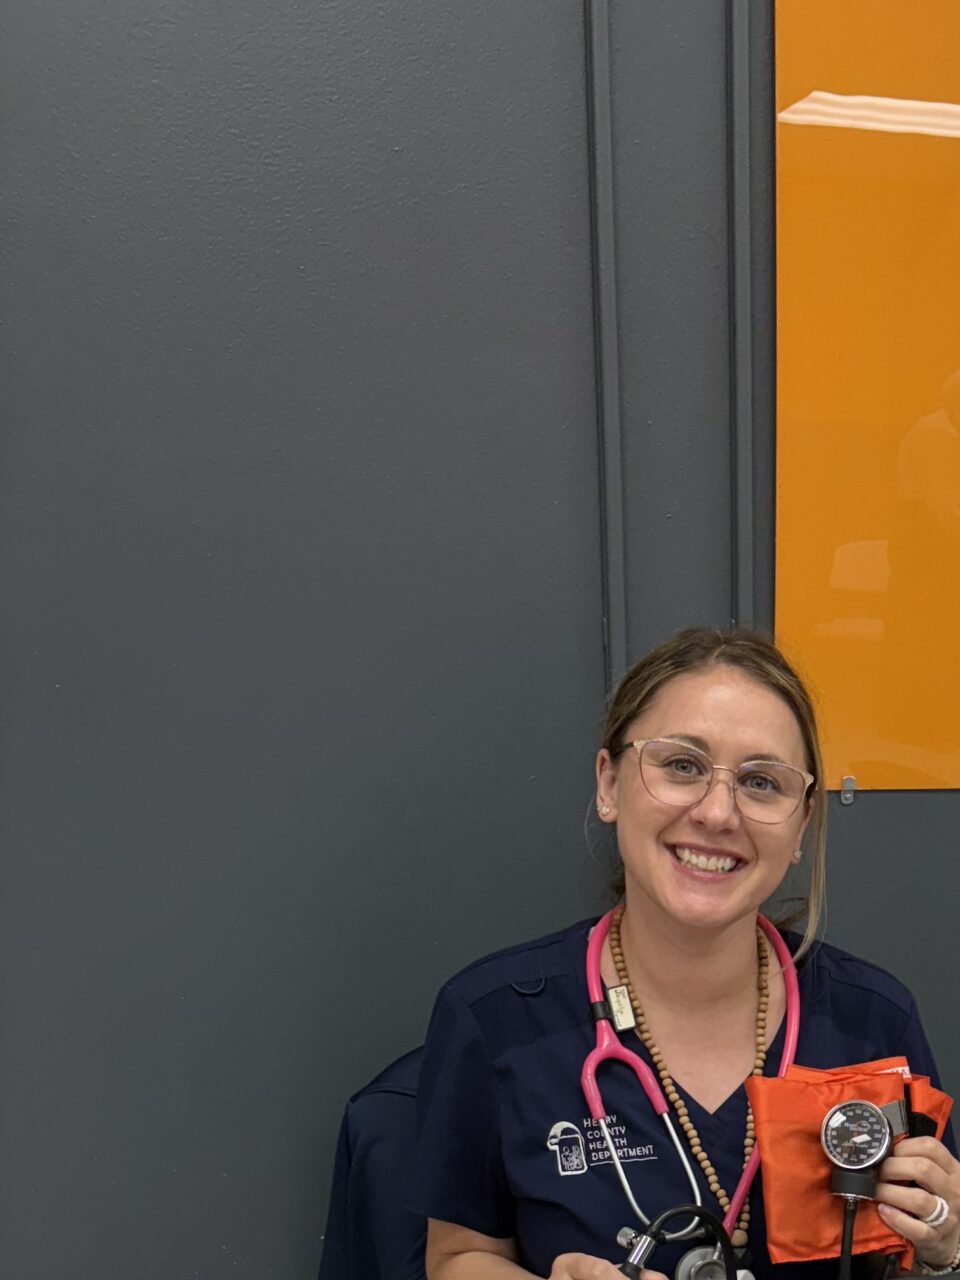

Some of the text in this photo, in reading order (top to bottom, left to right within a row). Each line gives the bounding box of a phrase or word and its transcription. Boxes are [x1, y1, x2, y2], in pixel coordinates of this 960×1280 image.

[583, 1114, 617, 1128] HERY
[589, 1137, 627, 1150] HEATH
[591, 1145, 654, 1161] DEPRTMENT
